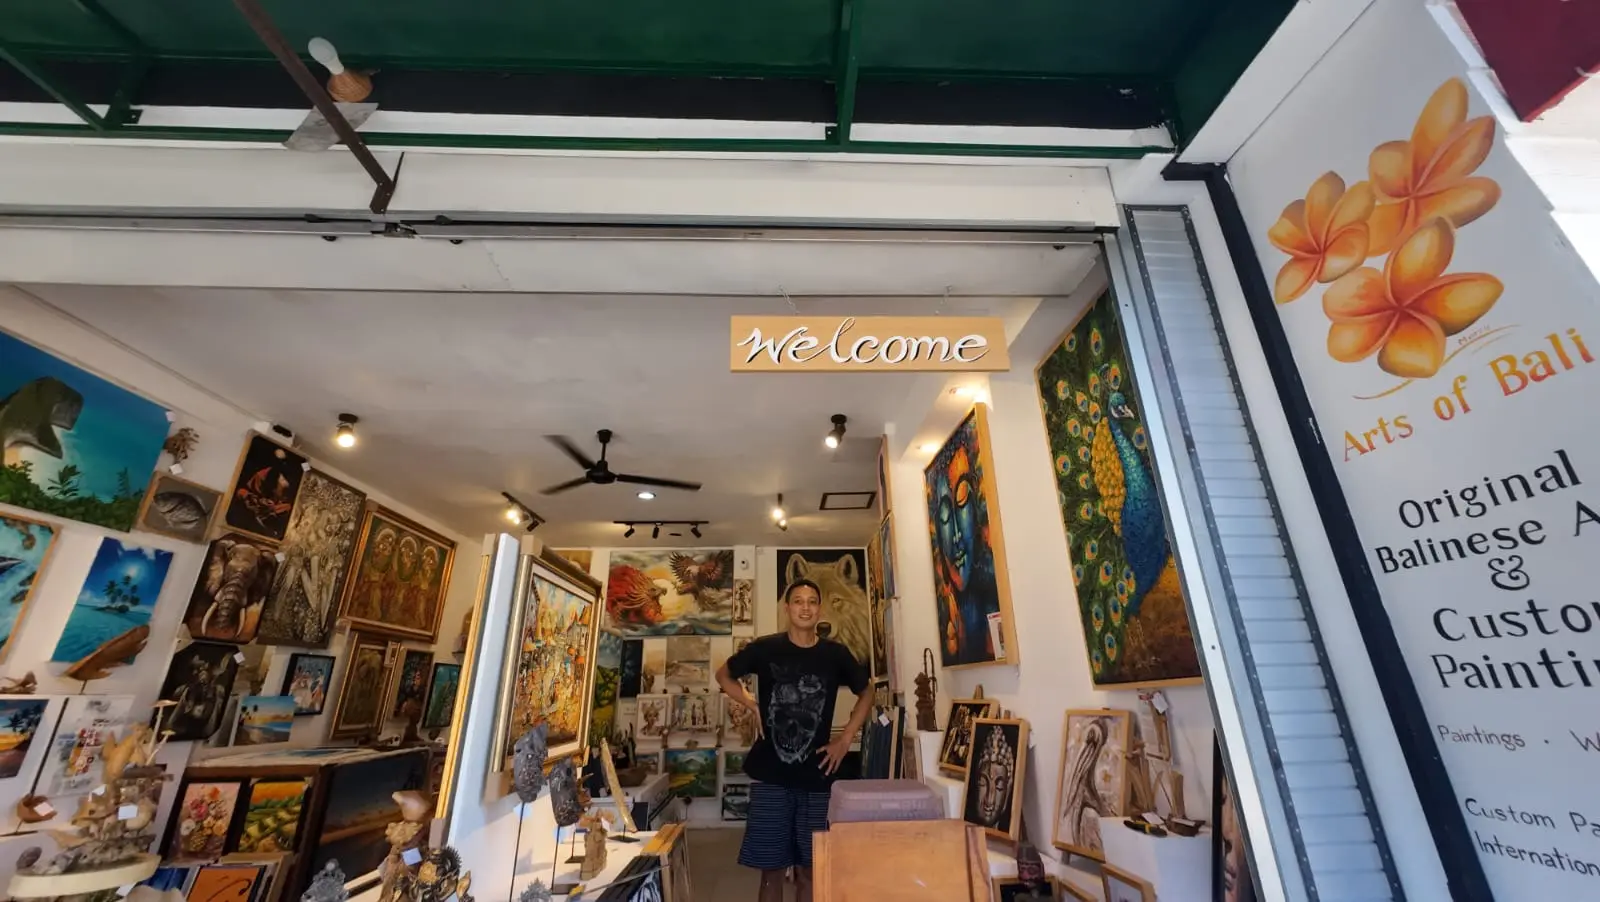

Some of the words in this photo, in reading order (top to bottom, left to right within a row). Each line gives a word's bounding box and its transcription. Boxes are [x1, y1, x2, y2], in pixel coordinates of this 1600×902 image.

[736, 316, 990, 365] Welcome
[1343, 415, 1413, 462] Arts
[1433, 375, 1471, 421] of
[1488, 328, 1596, 396] Bali
[1398, 449, 1582, 529] Original
[1375, 519, 1547, 574] Balinese
[1487, 554, 1531, 591] &
[1433, 599, 1600, 642] Custo
[1431, 647, 1600, 689] Painti
[1437, 724, 1526, 752] Paintings
[1465, 798, 1557, 829] Custom
